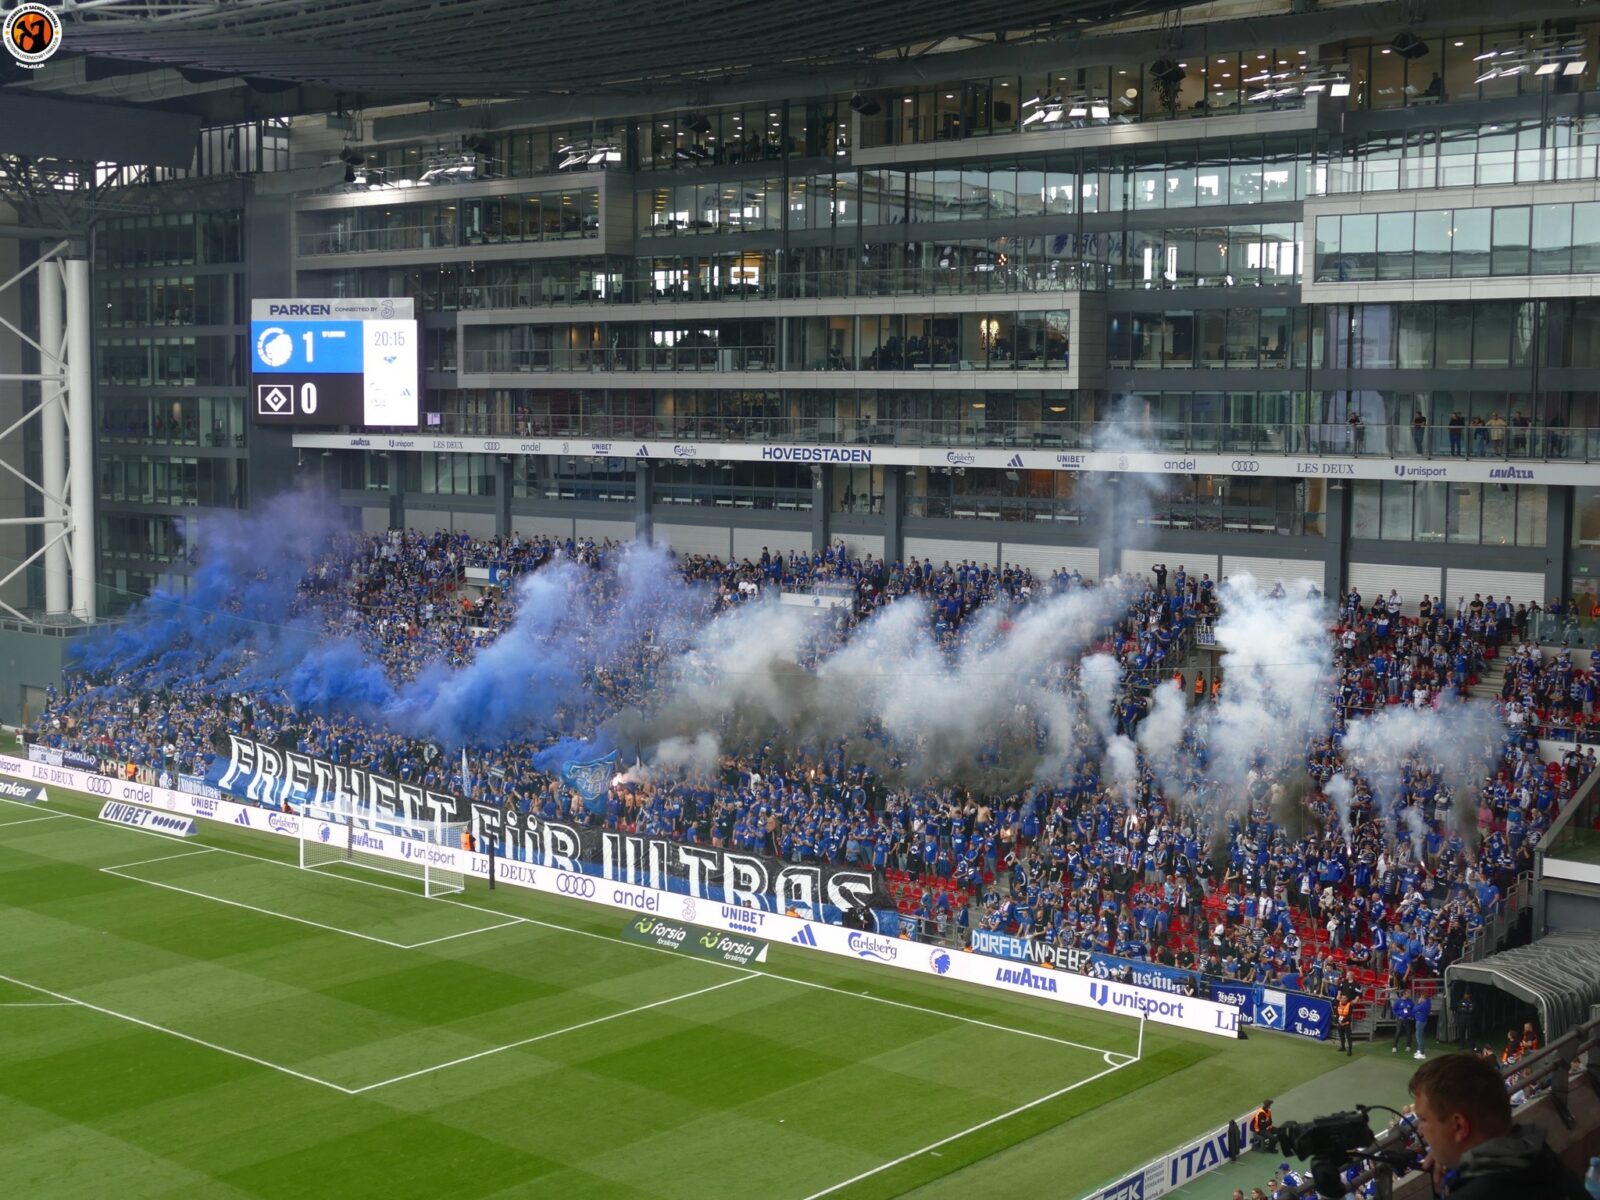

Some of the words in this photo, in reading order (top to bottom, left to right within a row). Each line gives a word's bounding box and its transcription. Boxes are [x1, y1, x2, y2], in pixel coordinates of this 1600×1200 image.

[269, 304, 331, 315] PARKEN
[302, 331, 314, 362] 1
[374, 331, 405, 346] 20:15
[301, 382, 317, 414] 0
[433, 441, 445, 449] LES
[446, 441, 464, 449] DEUX
[520, 442, 541, 452] andel
[591, 443, 612, 451] UNIBET
[674, 445, 697, 457] Carlsberg
[762, 447, 872, 462] HOVEDSTADEN
[946, 451, 975, 465] Carlsberg
[1056, 454, 1086, 464] UNIBET
[1163, 459, 1196, 471] andel
[1297, 463, 1319, 474] LES
[1322, 463, 1355, 475] DEUX
[1407, 466, 1447, 478] unisport
[1489, 466, 1534, 479] LAVAZZA
[32, 765, 50, 781] LES
[50, 769, 75, 787] DEUX
[123, 785, 153, 804] andel
[191, 796, 219, 812] UNIBET
[103, 801, 152, 826] UNIBET
[268, 812, 299, 835] Carlsberg
[471, 857, 496, 874] LE
[500, 863, 537, 885] DEUX
[613, 888, 660, 912] andel
[721, 905, 766, 926] UNIBET
[651, 921, 687, 942] forsia
[715, 936, 754, 957] forsia
[847, 931, 898, 962] Carlsberg
[723, 952, 749, 965] forsikring
[995, 967, 1058, 993] LAVAZZA
[1112, 990, 1185, 1018] unisport
[1217, 990, 1247, 1006] HSV
[1294, 1022, 1321, 1037] Land
